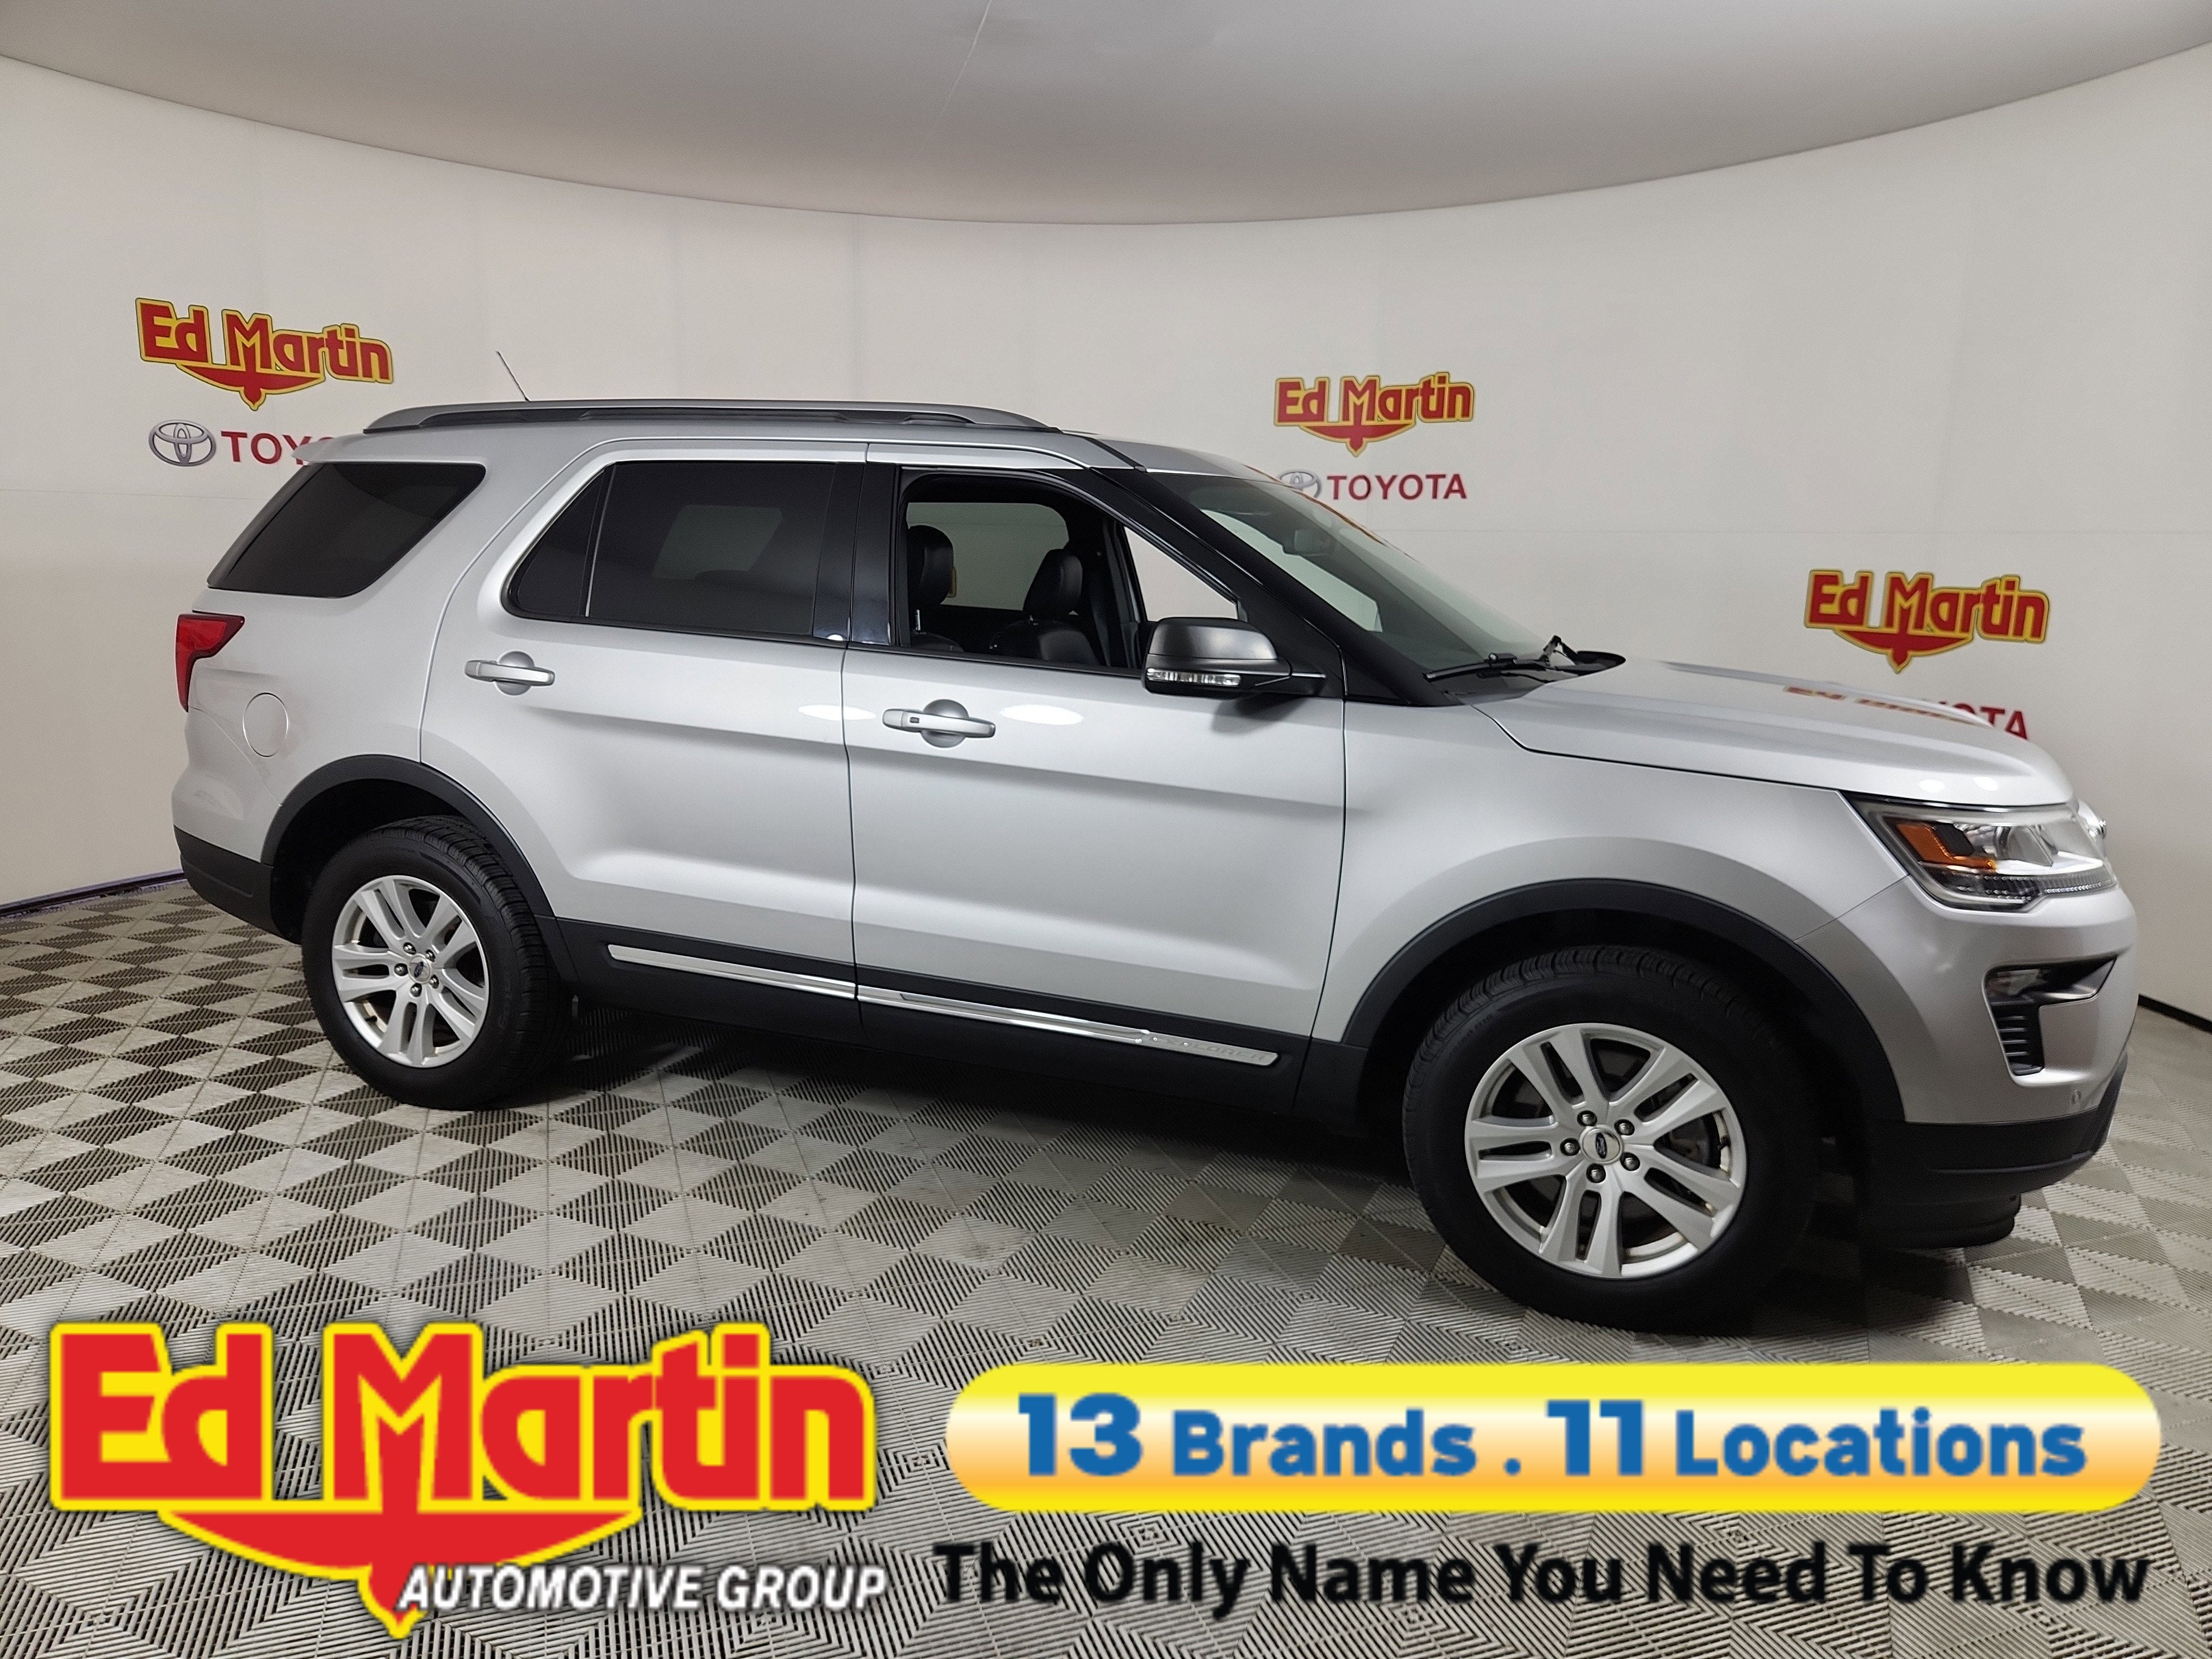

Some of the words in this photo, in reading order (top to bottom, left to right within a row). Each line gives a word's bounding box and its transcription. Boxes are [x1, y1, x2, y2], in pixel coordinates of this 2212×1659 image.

[139, 302, 209, 363] Ed
[225, 313, 390, 381] Martin
[1277, 381, 1327, 423] Ed
[1342, 375, 1471, 421] Martin
[1327, 473, 1467, 500] TOYOTA
[1808, 574, 1870, 627] Ed
[1884, 576, 2046, 639] Martin
